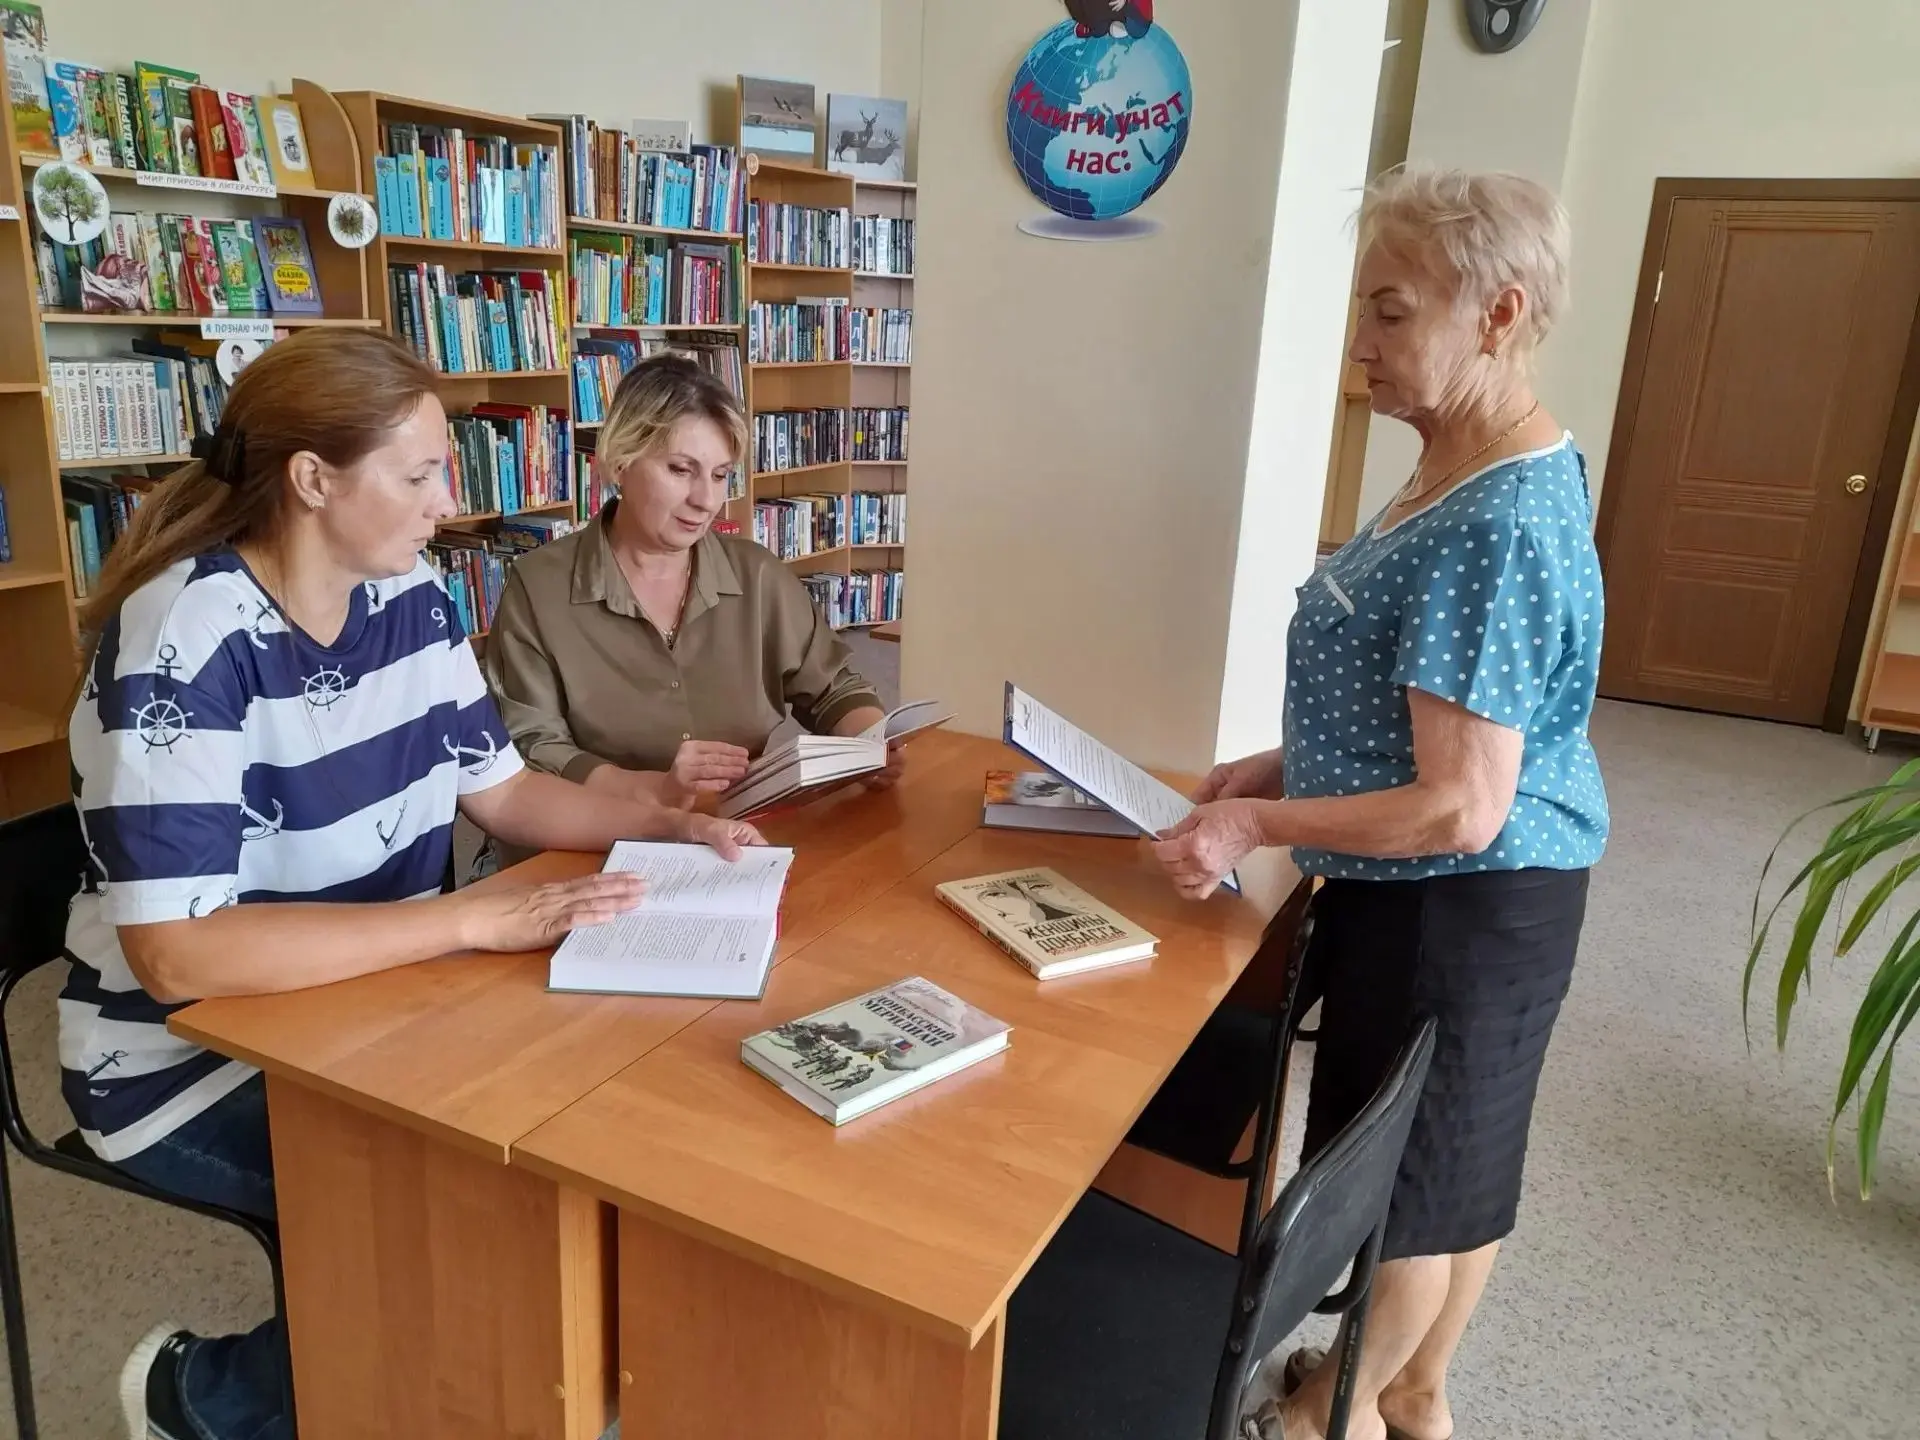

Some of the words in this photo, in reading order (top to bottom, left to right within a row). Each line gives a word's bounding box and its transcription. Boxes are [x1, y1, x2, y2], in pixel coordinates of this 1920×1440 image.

[1015, 81, 1105, 136] Книги
[1115, 92, 1185, 144] учат
[1066, 149, 1132, 174] нас:
[205, 323, 212, 333] Я
[215, 323, 251, 334] ПОЗНАЮ
[252, 323, 271, 334] МИР
[867, 512, 876, 524] Н
[1019, 914, 1110, 940] ЖЕНЩИНЫ
[1035, 925, 1127, 953] ДОНБАССА
[860, 999, 942, 1047] МЕРИДИАН
[877, 995, 958, 1041] ДОНБАССКИЙ
